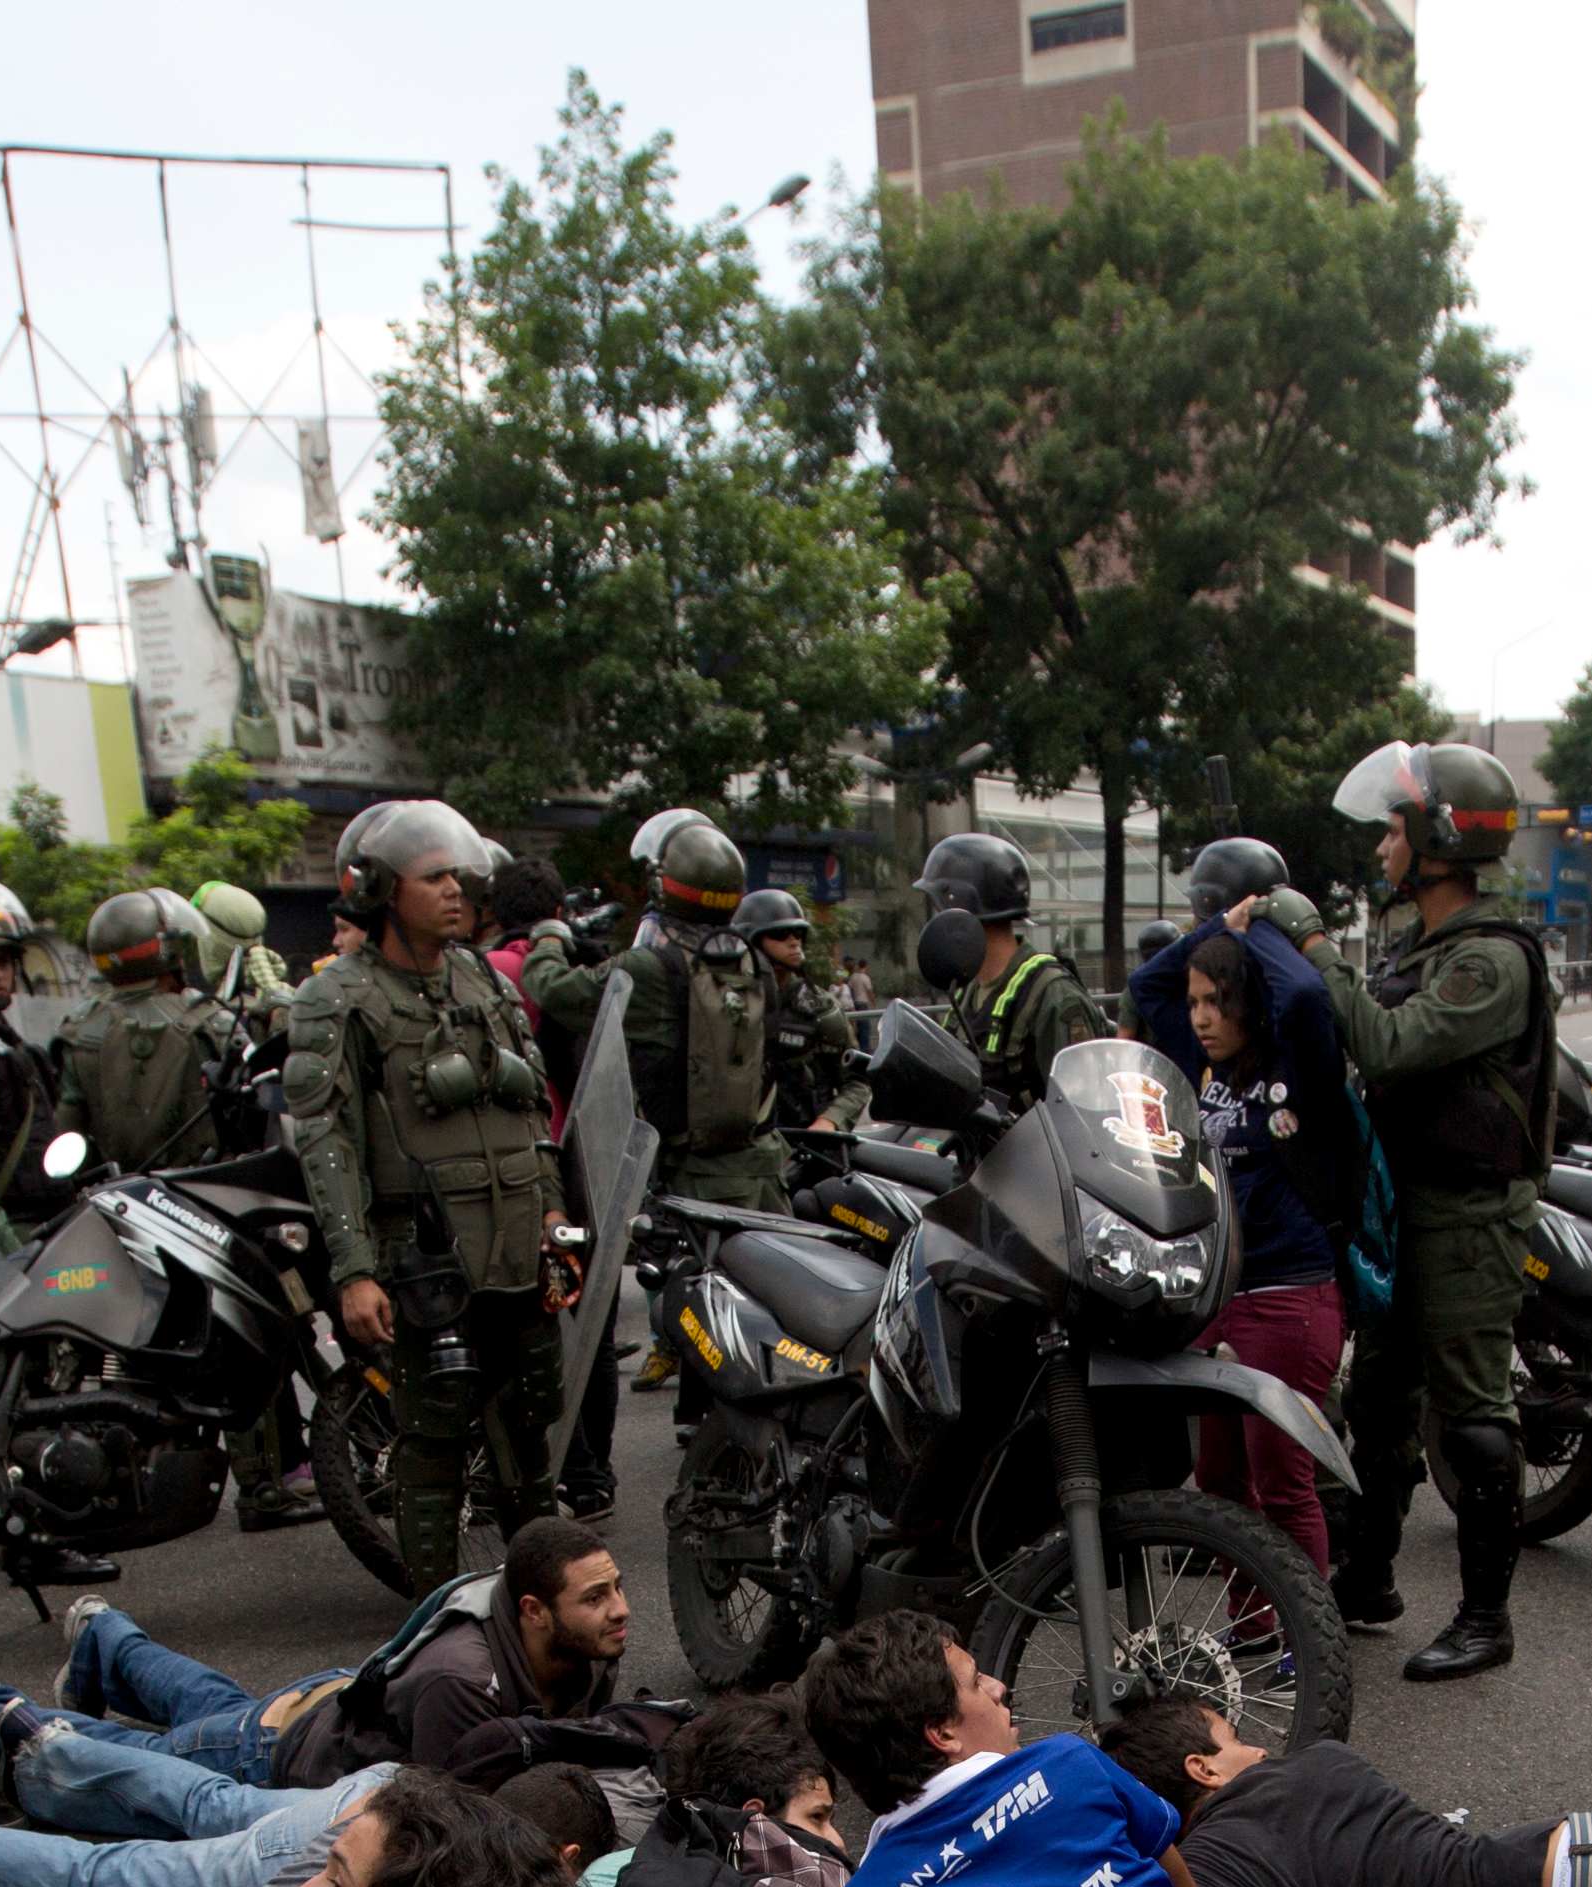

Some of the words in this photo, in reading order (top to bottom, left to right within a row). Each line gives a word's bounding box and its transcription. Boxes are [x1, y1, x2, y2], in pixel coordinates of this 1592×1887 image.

[146, 1188, 232, 1248] Kawasaki
[58, 1266, 96, 1292] GNB
[775, 1338, 831, 1373] DM-51
[972, 1770, 1049, 1841] TAM
